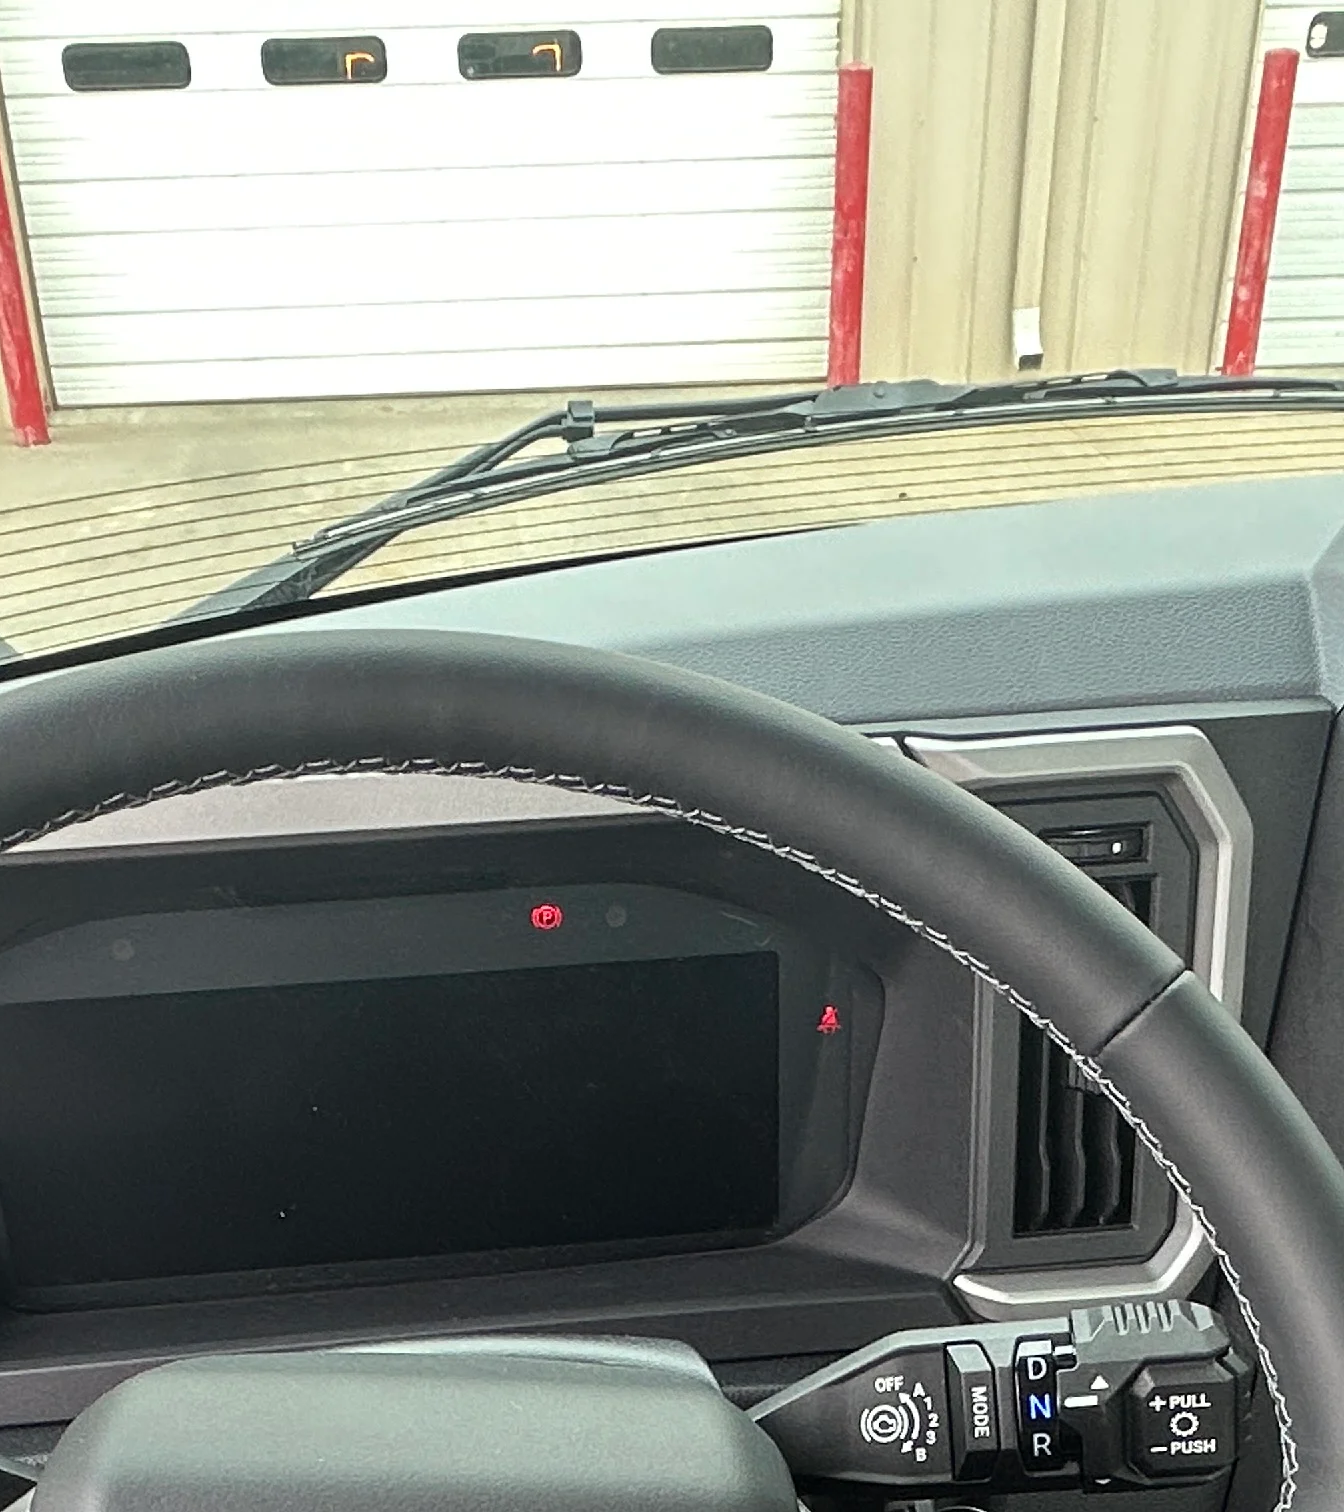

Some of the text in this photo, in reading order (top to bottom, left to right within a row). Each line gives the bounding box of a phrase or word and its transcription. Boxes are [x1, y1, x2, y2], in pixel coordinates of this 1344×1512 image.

[1027, 1357, 1047, 1380] D
[875, 1376, 904, 1393] OFF
[912, 1382, 926, 1398] A
[923, 1396, 932, 1411] 1
[1029, 1393, 1052, 1419] N
[928, 1412, 940, 1428] 2
[971, 1386, 990, 1438] MODE
[925, 1430, 937, 1445] 3
[1032, 1432, 1052, 1457] R
[915, 1447, 927, 1462] B
